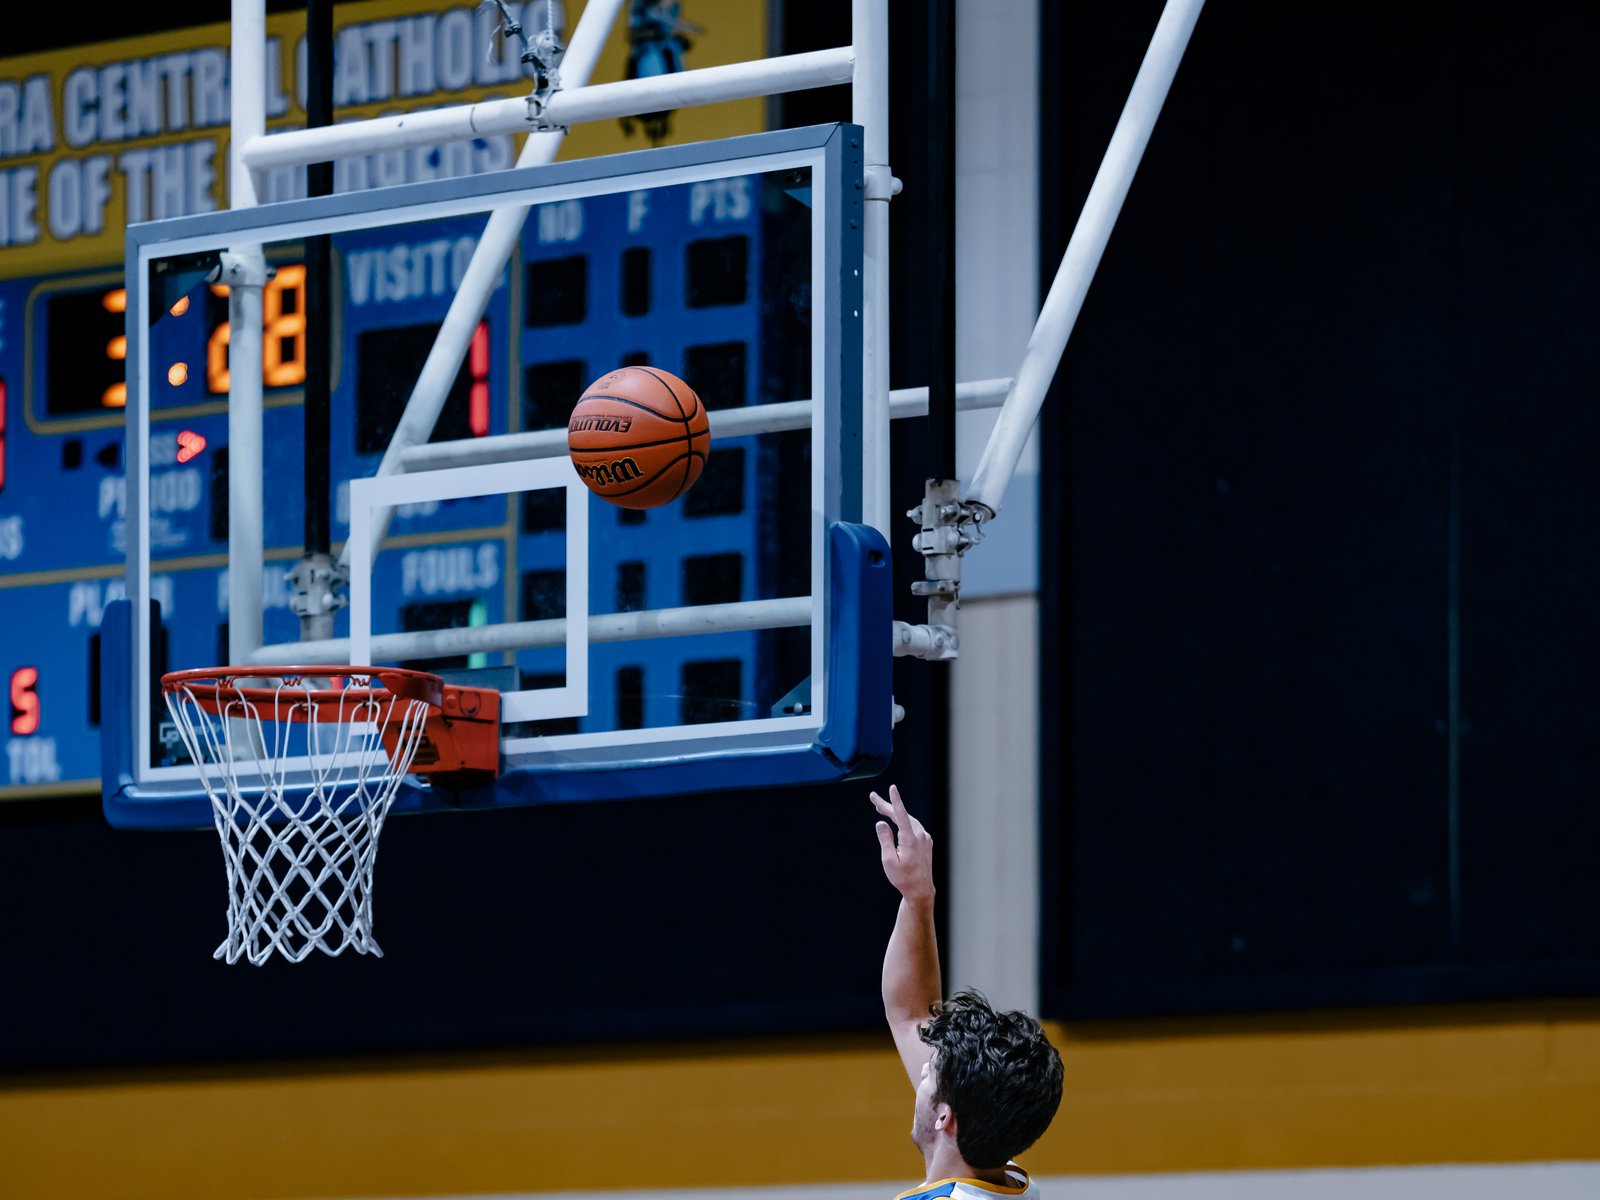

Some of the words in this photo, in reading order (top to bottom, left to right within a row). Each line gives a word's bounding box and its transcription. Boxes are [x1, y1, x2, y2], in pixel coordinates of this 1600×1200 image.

[64, 38, 289, 148] CENTRL
[49, 153, 112, 240] OF
[118, 137, 217, 224] THE
[628, 188, 650, 233] F
[689, 176, 752, 225] PTS
[348, 234, 506, 305] VISITO
[569, 418, 633, 433] EVOLUTIO
[402, 542, 500, 597] FOULS
[10, 666, 40, 735] 5
